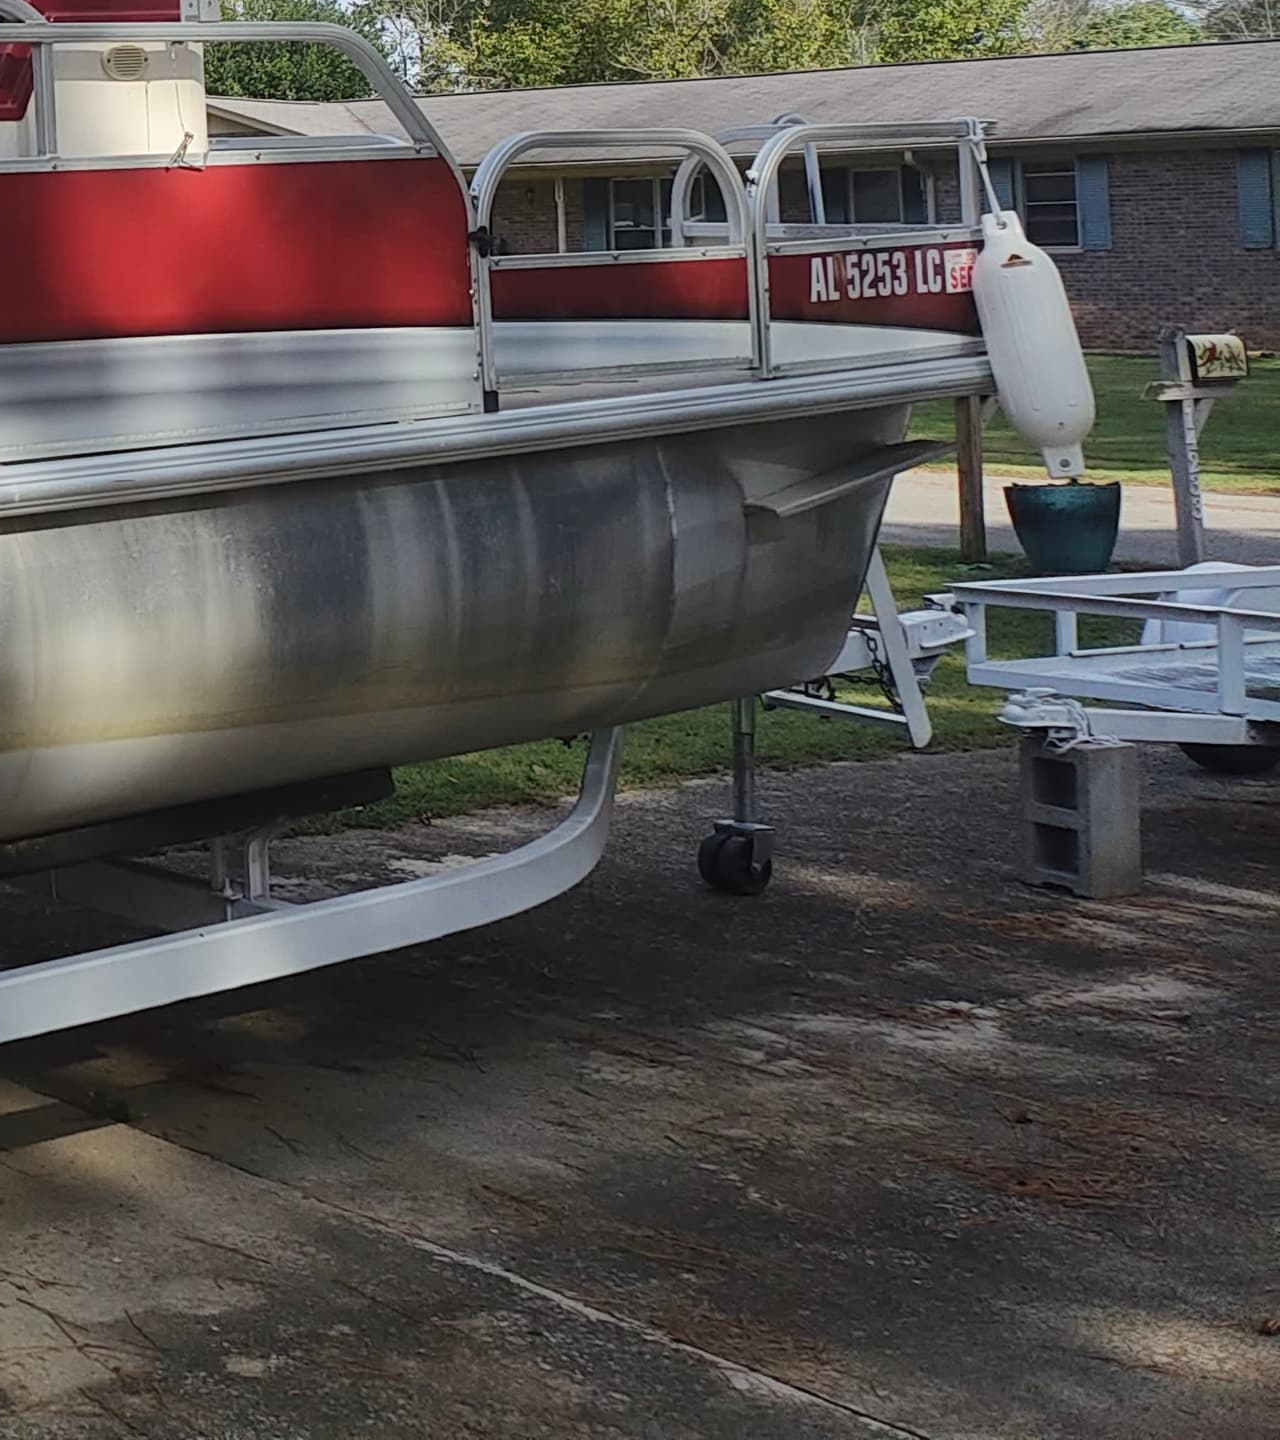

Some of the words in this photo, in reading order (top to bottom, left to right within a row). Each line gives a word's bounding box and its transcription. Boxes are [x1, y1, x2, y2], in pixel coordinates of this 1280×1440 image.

[810, 255, 840, 303] AL
[846, 251, 908, 299] 5253
[915, 248, 942, 294] LC
